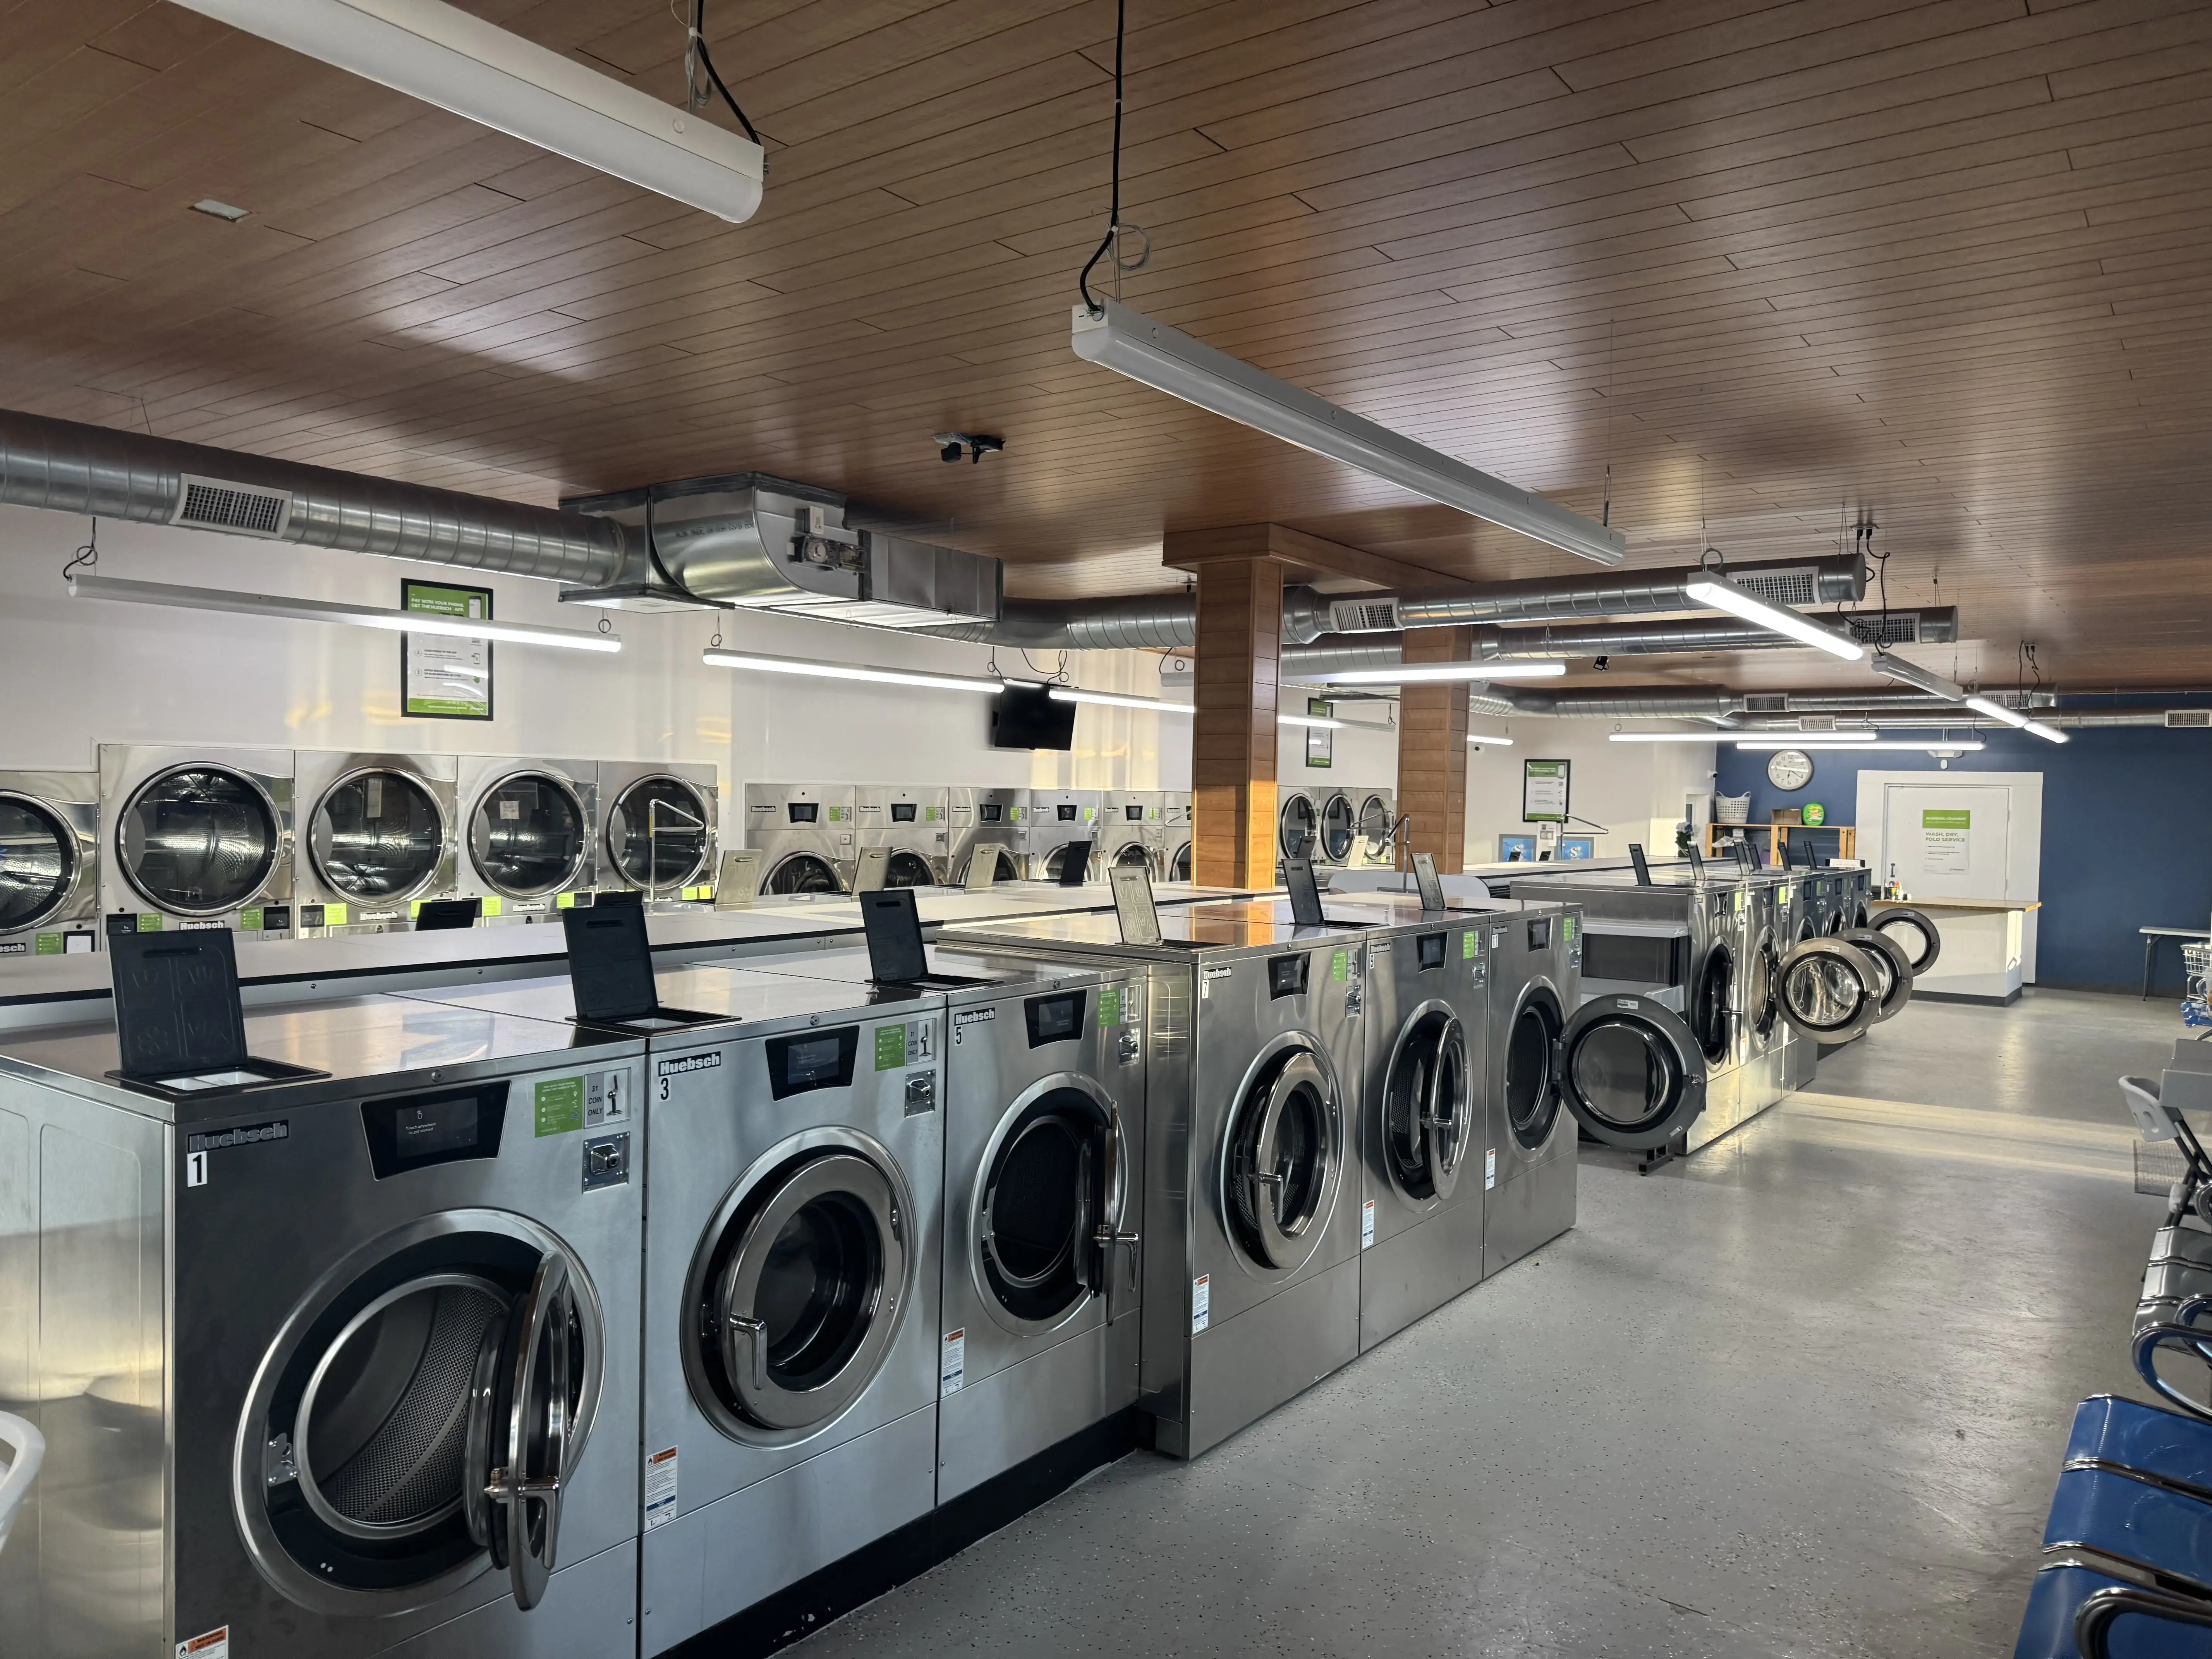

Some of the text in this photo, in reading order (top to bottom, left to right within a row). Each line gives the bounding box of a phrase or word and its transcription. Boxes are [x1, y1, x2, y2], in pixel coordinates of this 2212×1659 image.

[180, 921, 224, 930] Huebsch
[1370, 955, 1374, 967] 9
[1204, 982, 1207, 997] 7
[955, 1009, 994, 1024] Huebsch
[956, 1026, 962, 1045] 5
[660, 1054, 720, 1075] Huebsch
[660, 1078, 669, 1100] 3
[588, 1096, 602, 1104] COIN
[588, 1107, 603, 1116] ONLY
[189, 1123, 287, 1152] Huebsch
[192, 1154, 202, 1183] 1
